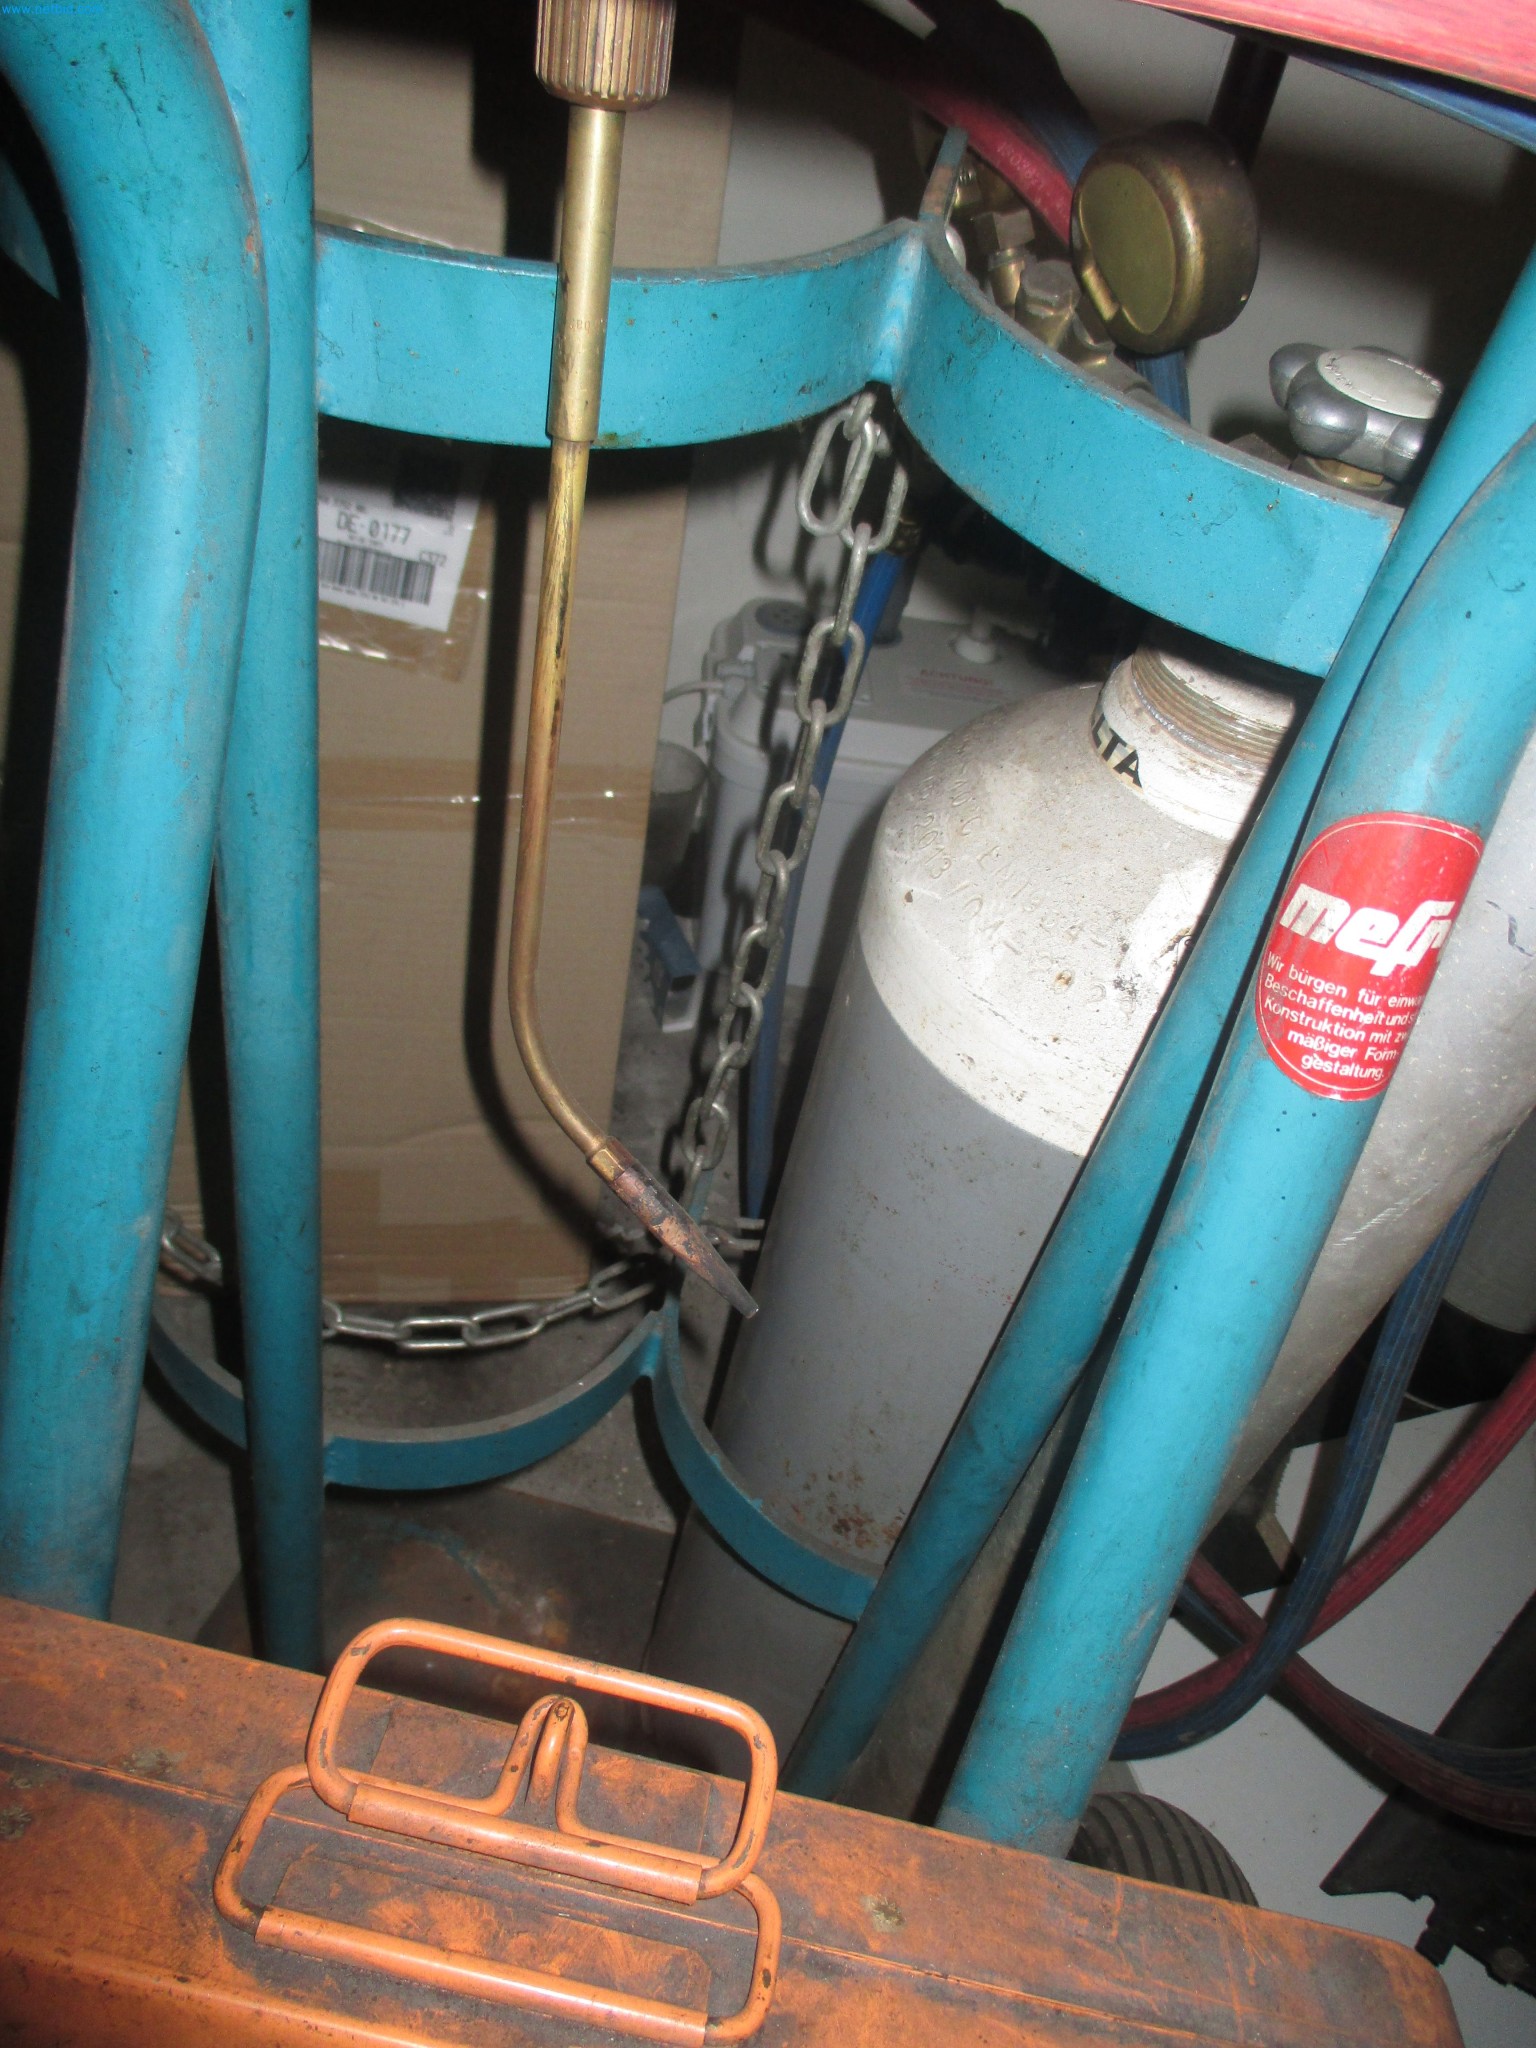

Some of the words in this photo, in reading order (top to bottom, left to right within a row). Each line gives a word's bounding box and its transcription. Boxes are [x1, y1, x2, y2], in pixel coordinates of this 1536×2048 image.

[1264, 973, 1387, 1025] Beschaffenheit
[1266, 951, 1285, 973] Wir
[1288, 963, 1348, 998] bürgen
[1357, 988, 1382, 1007] für
[1264, 996, 1365, 1042] Konstruktion
[1369, 1028, 1392, 1044] mit
[1287, 1030, 1358, 1059] mäßiger
[1301, 1052, 1385, 1081] gestaltung.
